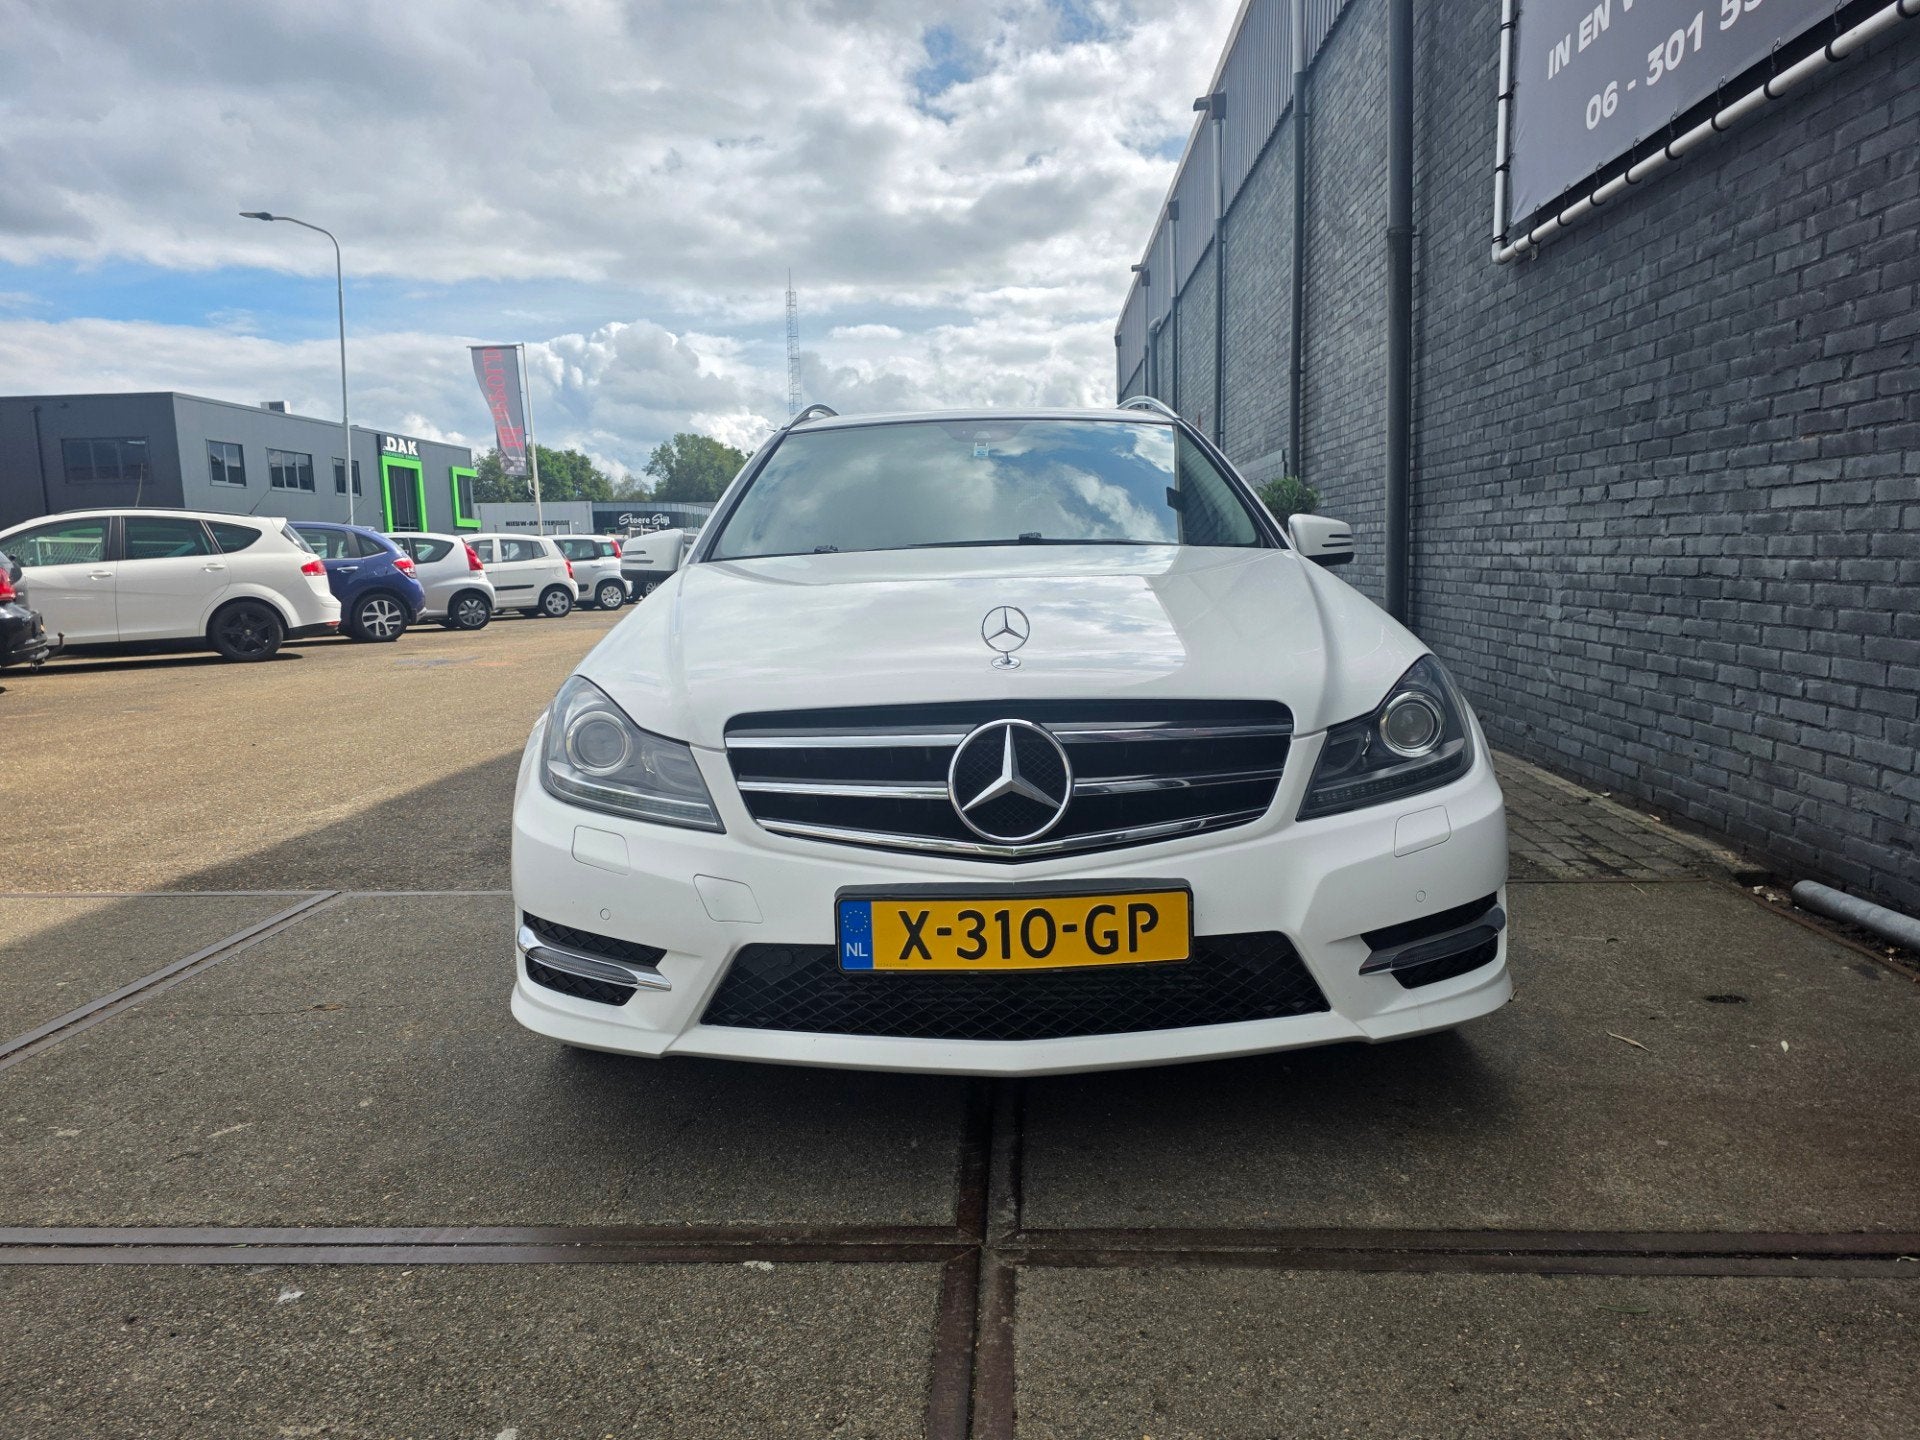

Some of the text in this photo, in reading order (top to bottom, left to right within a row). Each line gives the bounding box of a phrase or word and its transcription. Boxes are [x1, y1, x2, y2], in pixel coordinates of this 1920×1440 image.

[1548, 0, 1611, 80] IN EN
[1586, 80, 1618, 130] 06
[1646, 10, 1704, 86] 301
[1719, 0, 1762, 31] 5
[386, 436, 418, 456] DAK
[618, 513, 671, 526] Stoere Stijl
[846, 942, 868, 957] NL
[898, 903, 1159, 960] X-310-GP
